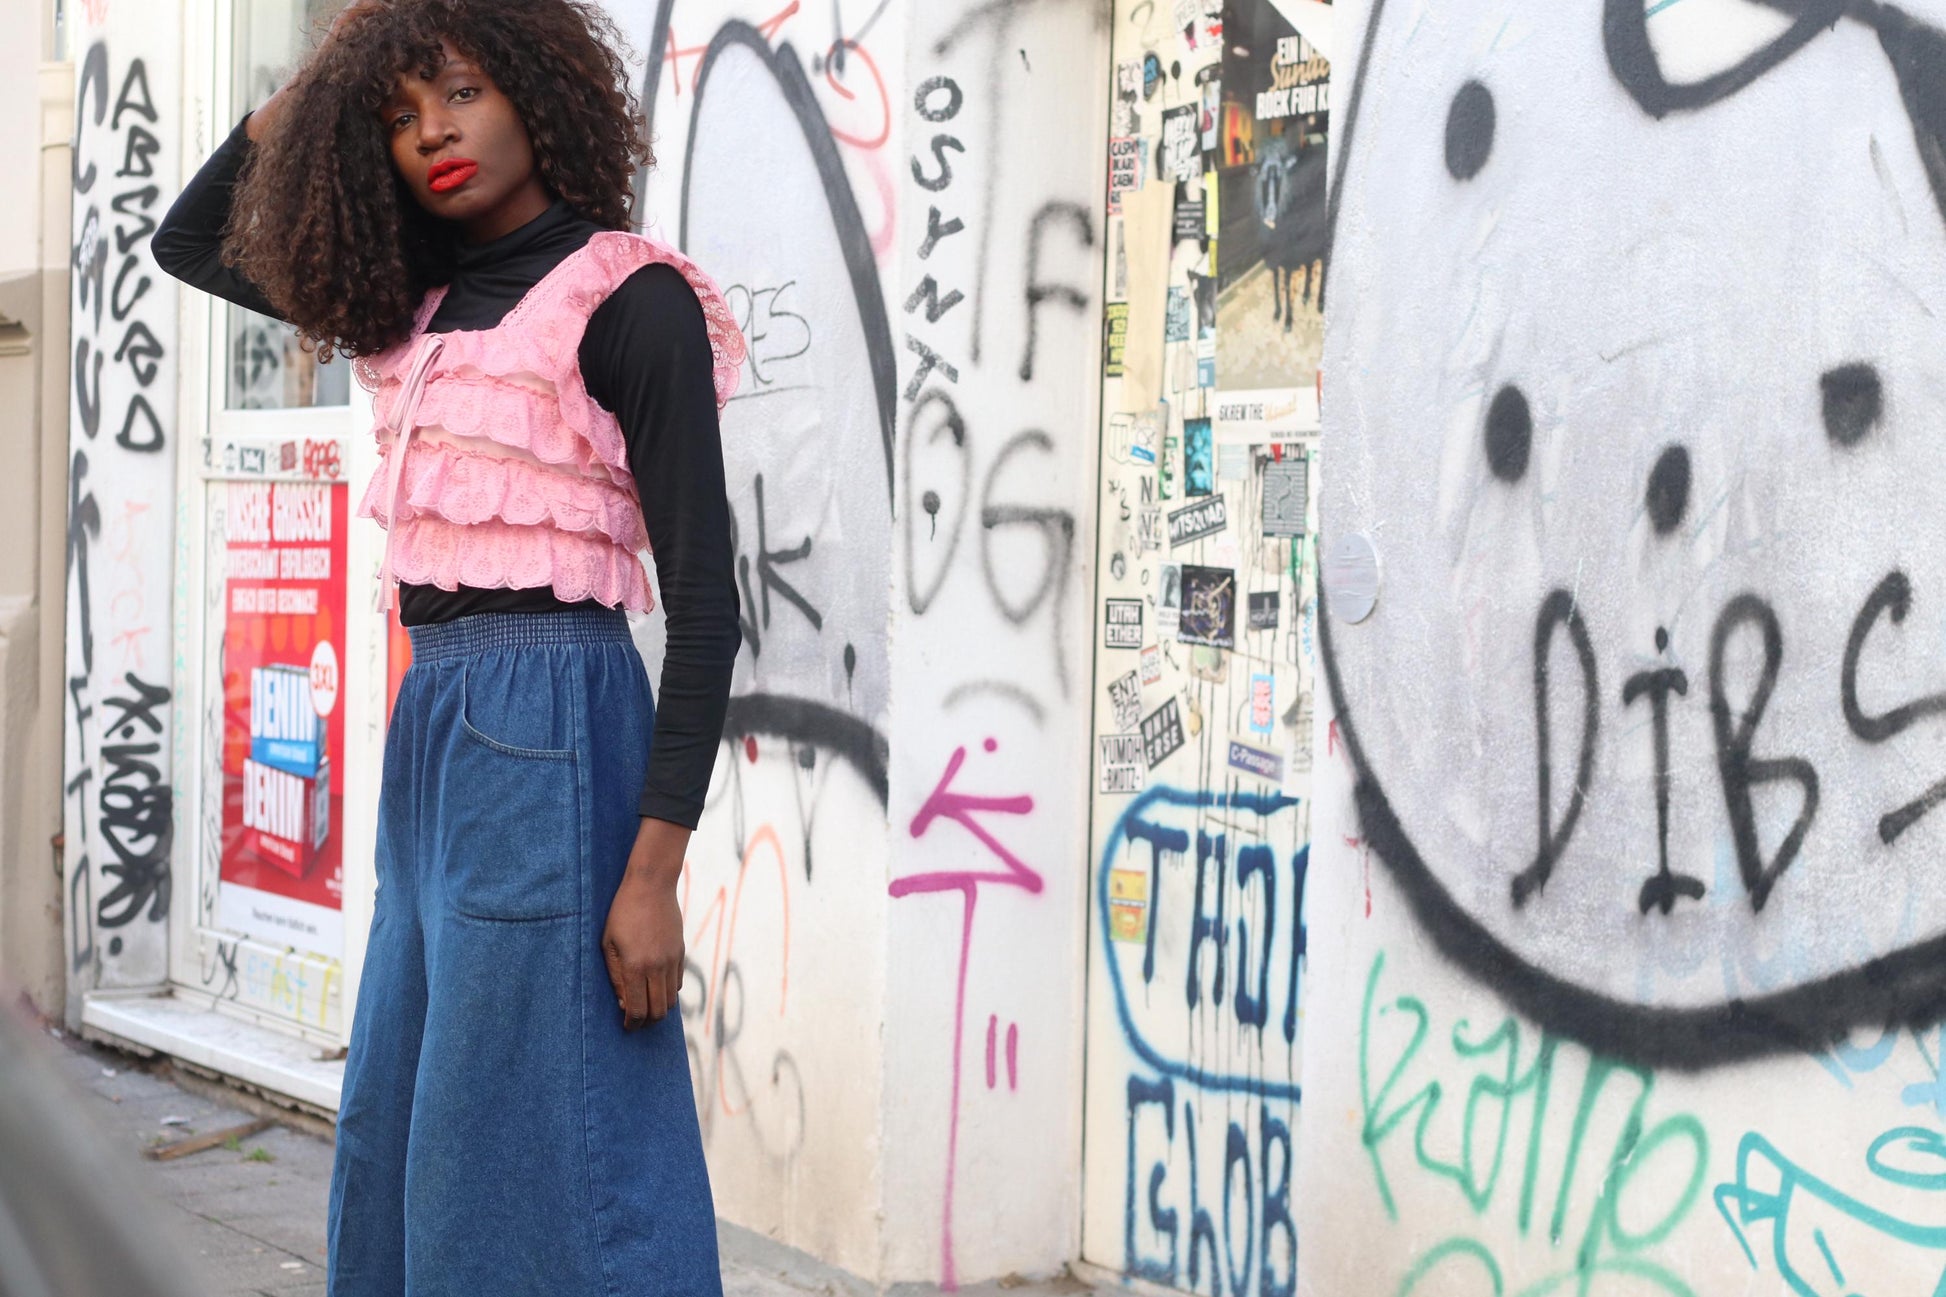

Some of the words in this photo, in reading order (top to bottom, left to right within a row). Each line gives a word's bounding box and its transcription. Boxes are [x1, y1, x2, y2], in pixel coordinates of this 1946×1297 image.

[1256, 89, 1290, 120] BOCK
[111, 58, 165, 453] ABSURD
[1249, 403, 1263, 421] THE
[1143, 700, 1178, 741] UNIV
[1146, 724, 1180, 769] ERSE
